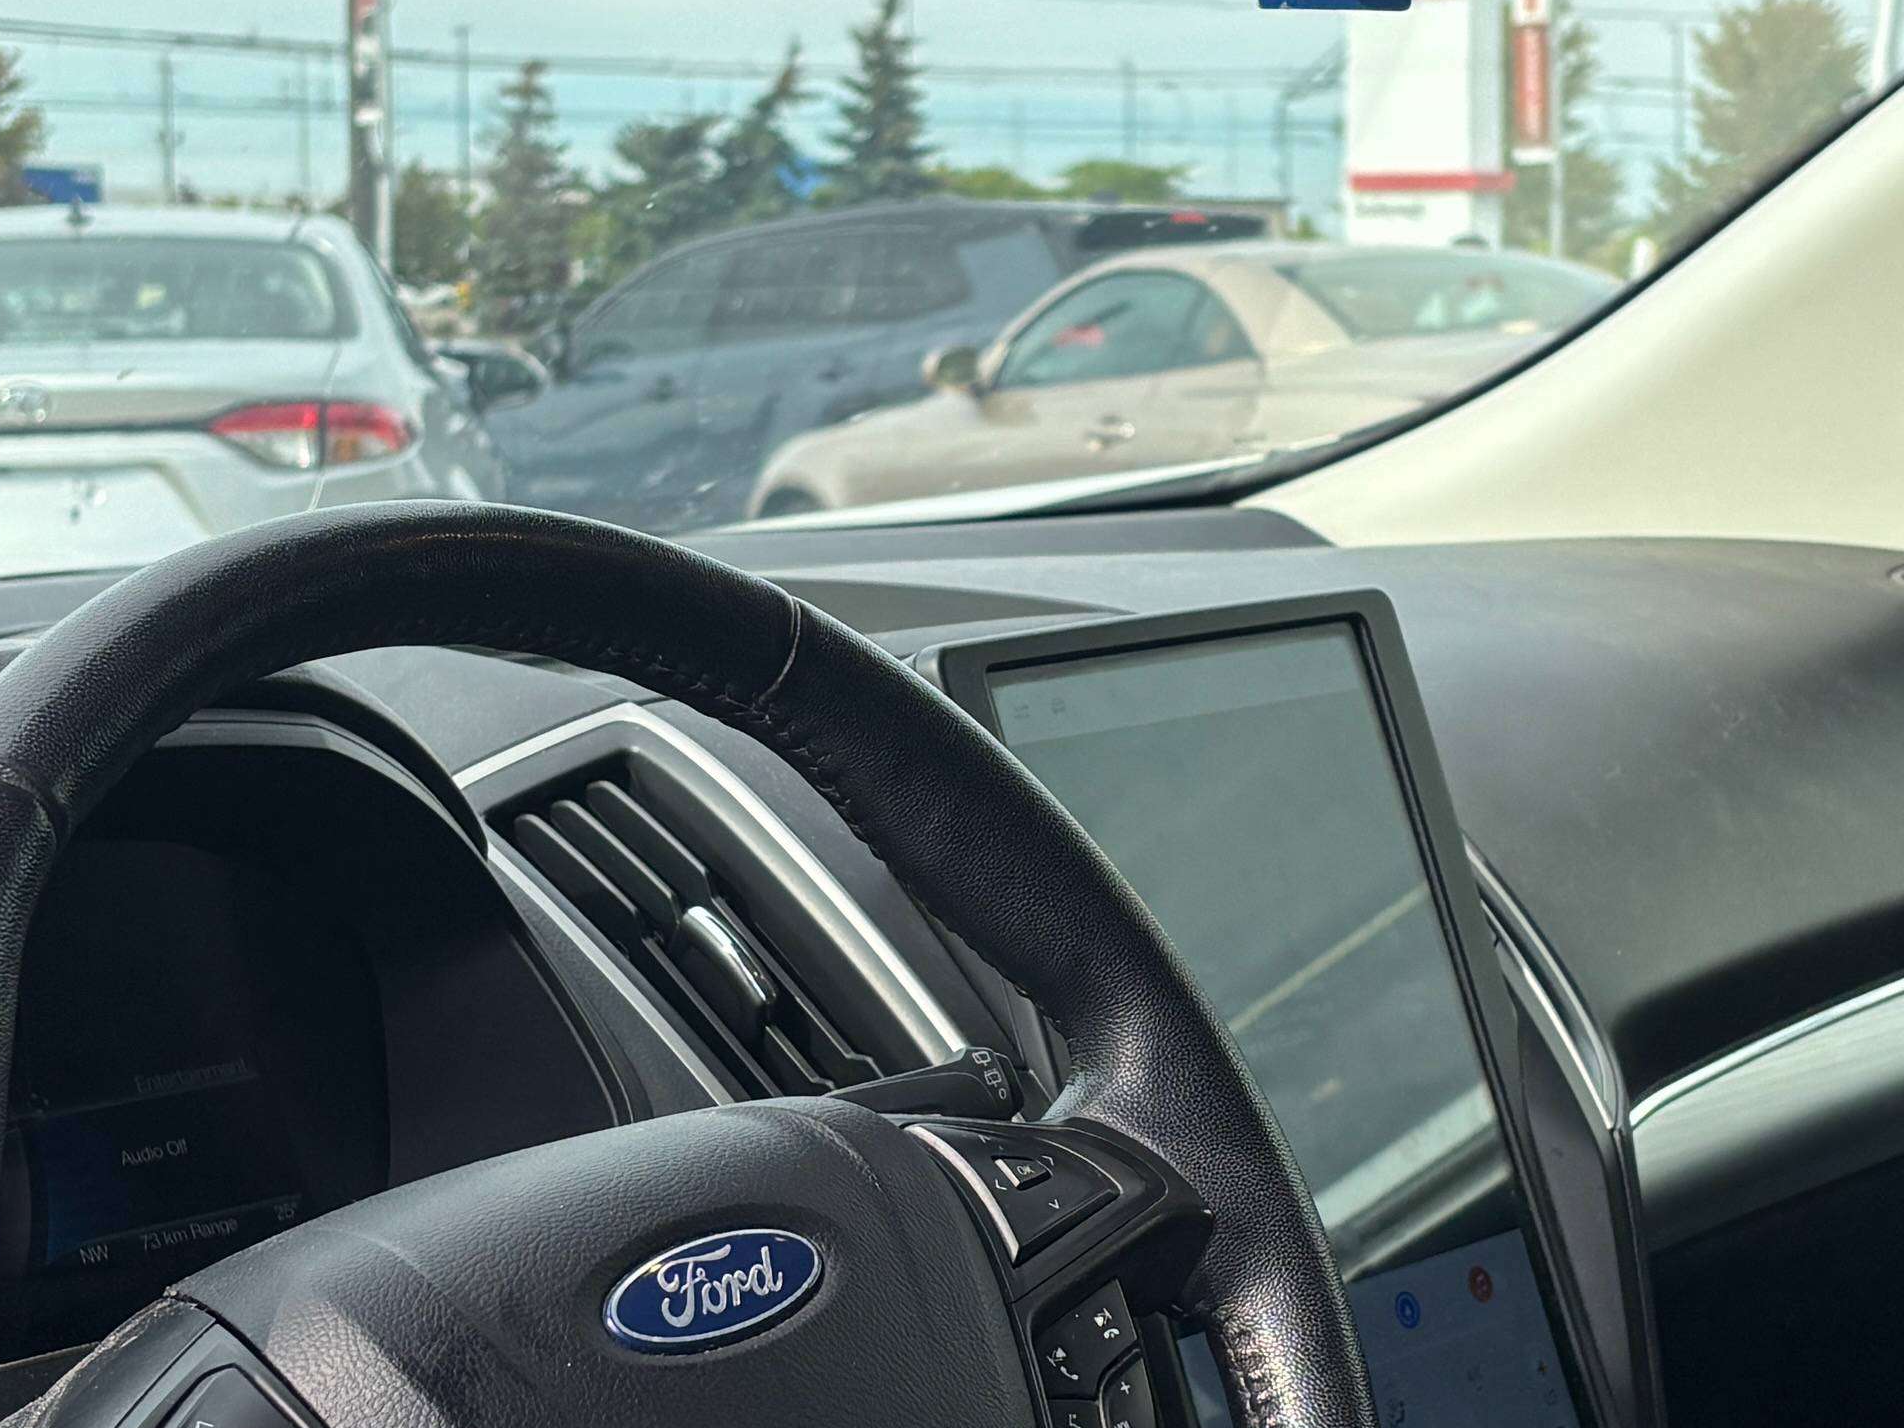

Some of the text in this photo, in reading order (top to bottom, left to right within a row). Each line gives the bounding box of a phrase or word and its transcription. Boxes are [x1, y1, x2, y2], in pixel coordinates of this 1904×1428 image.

[121, 1143, 164, 1167] Audio
[79, 1243, 109, 1266] NW
[163, 1228, 189, 1246] km
[189, 1217, 239, 1241] Range
[656, 1243, 784, 1329] Ford
